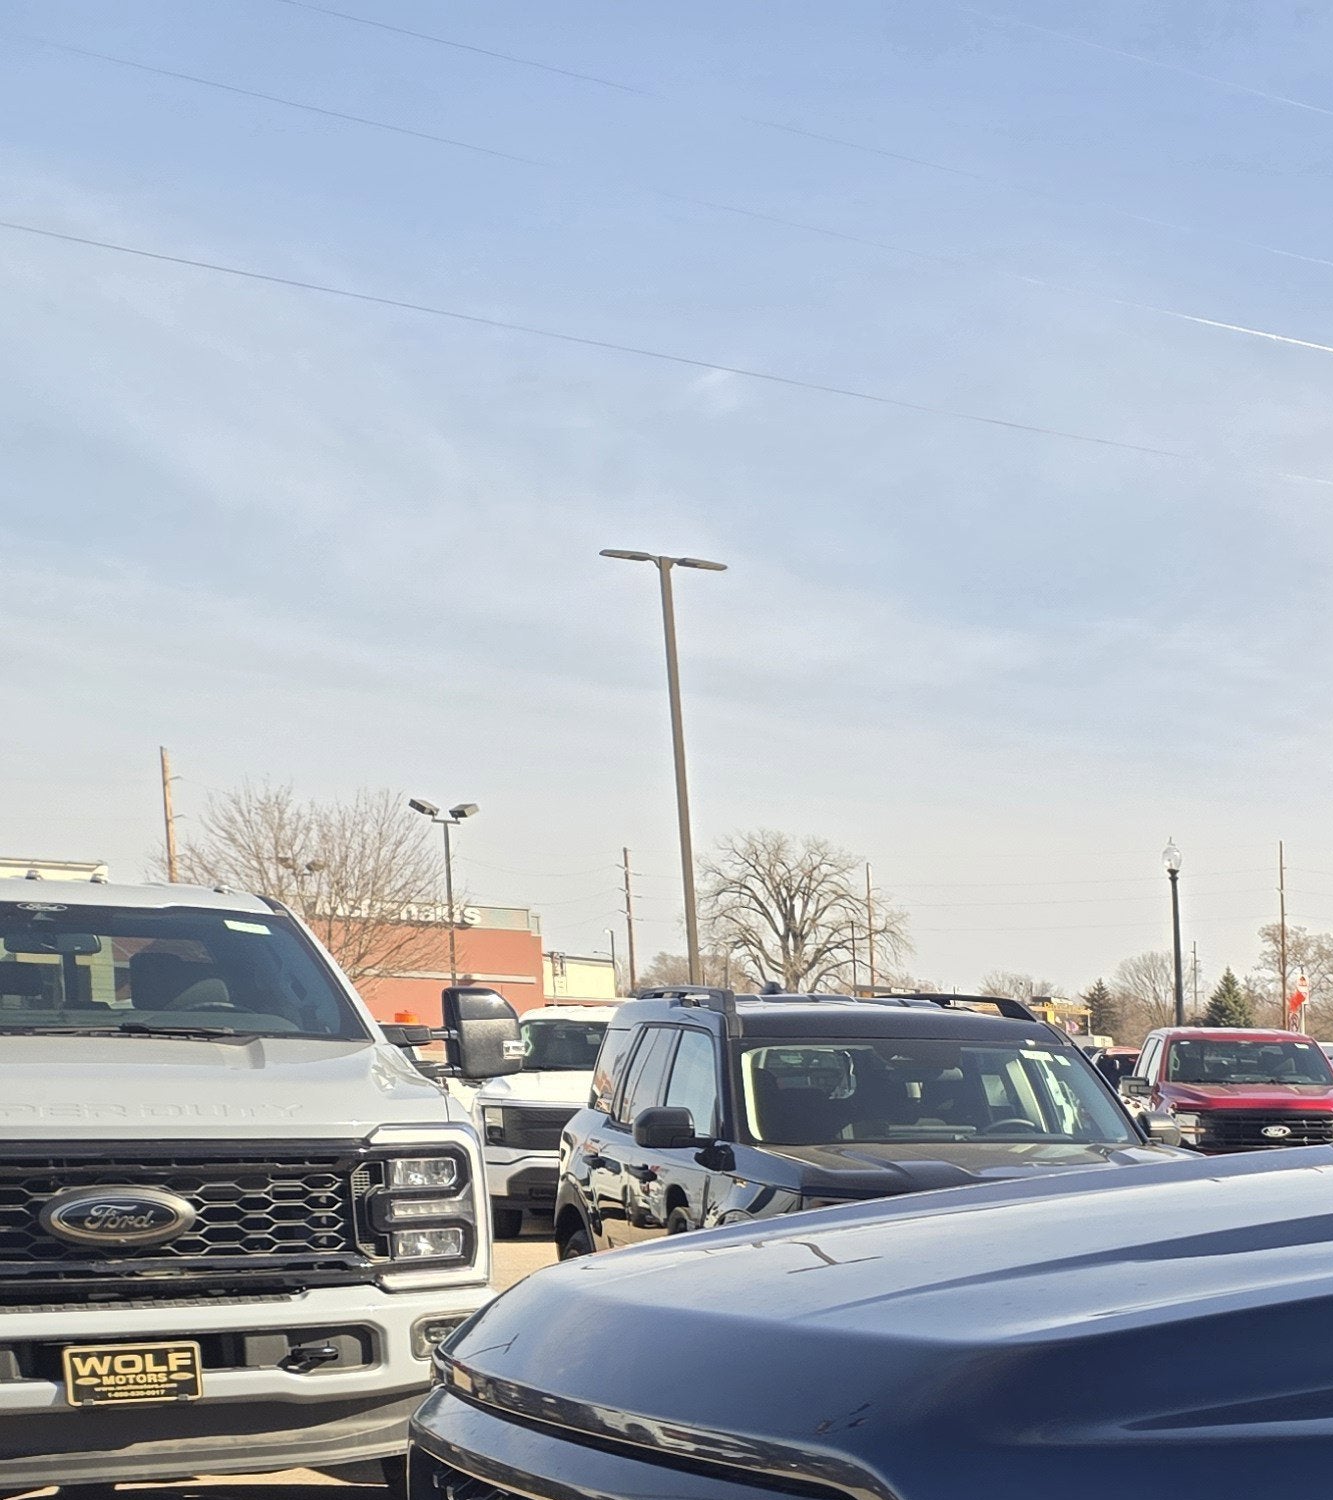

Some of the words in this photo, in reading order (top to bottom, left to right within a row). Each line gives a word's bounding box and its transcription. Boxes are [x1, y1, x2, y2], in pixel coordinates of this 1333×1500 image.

[84, 1204, 154, 1230] Ford
[72, 1352, 191, 1376] WOLF
[102, 1373, 168, 1385] MOTORS
